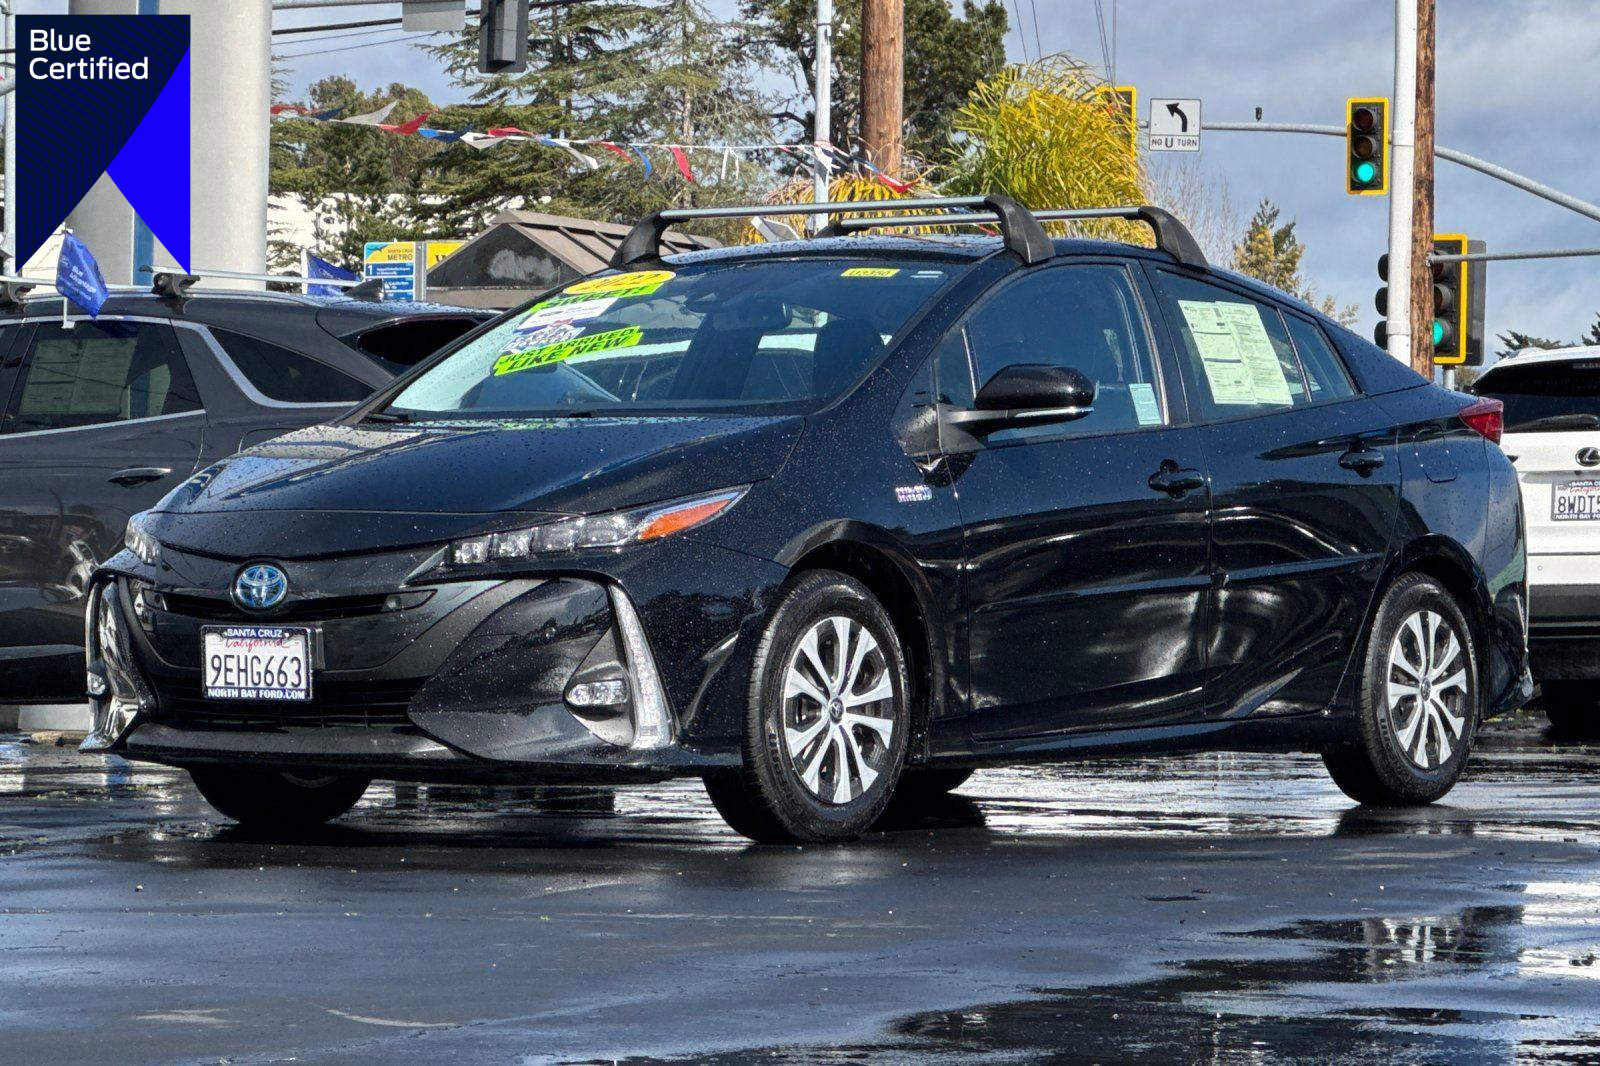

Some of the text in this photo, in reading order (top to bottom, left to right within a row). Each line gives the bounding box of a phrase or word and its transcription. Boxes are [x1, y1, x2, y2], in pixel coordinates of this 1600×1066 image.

[1151, 137, 1198, 148] NO U TURN
[387, 253, 413, 261] METRO
[367, 265, 373, 275] 1
[505, 347, 545, 364] JUST
[553, 328, 639, 351] ARRIVED
[506, 349, 563, 371] LIKE
[568, 336, 632, 358] NEW
[227, 628, 283, 638] SANTA CRUZ
[210, 654, 302, 688] 9EHG663
[207, 688, 306, 700] NORTH BAY FORD.COM
